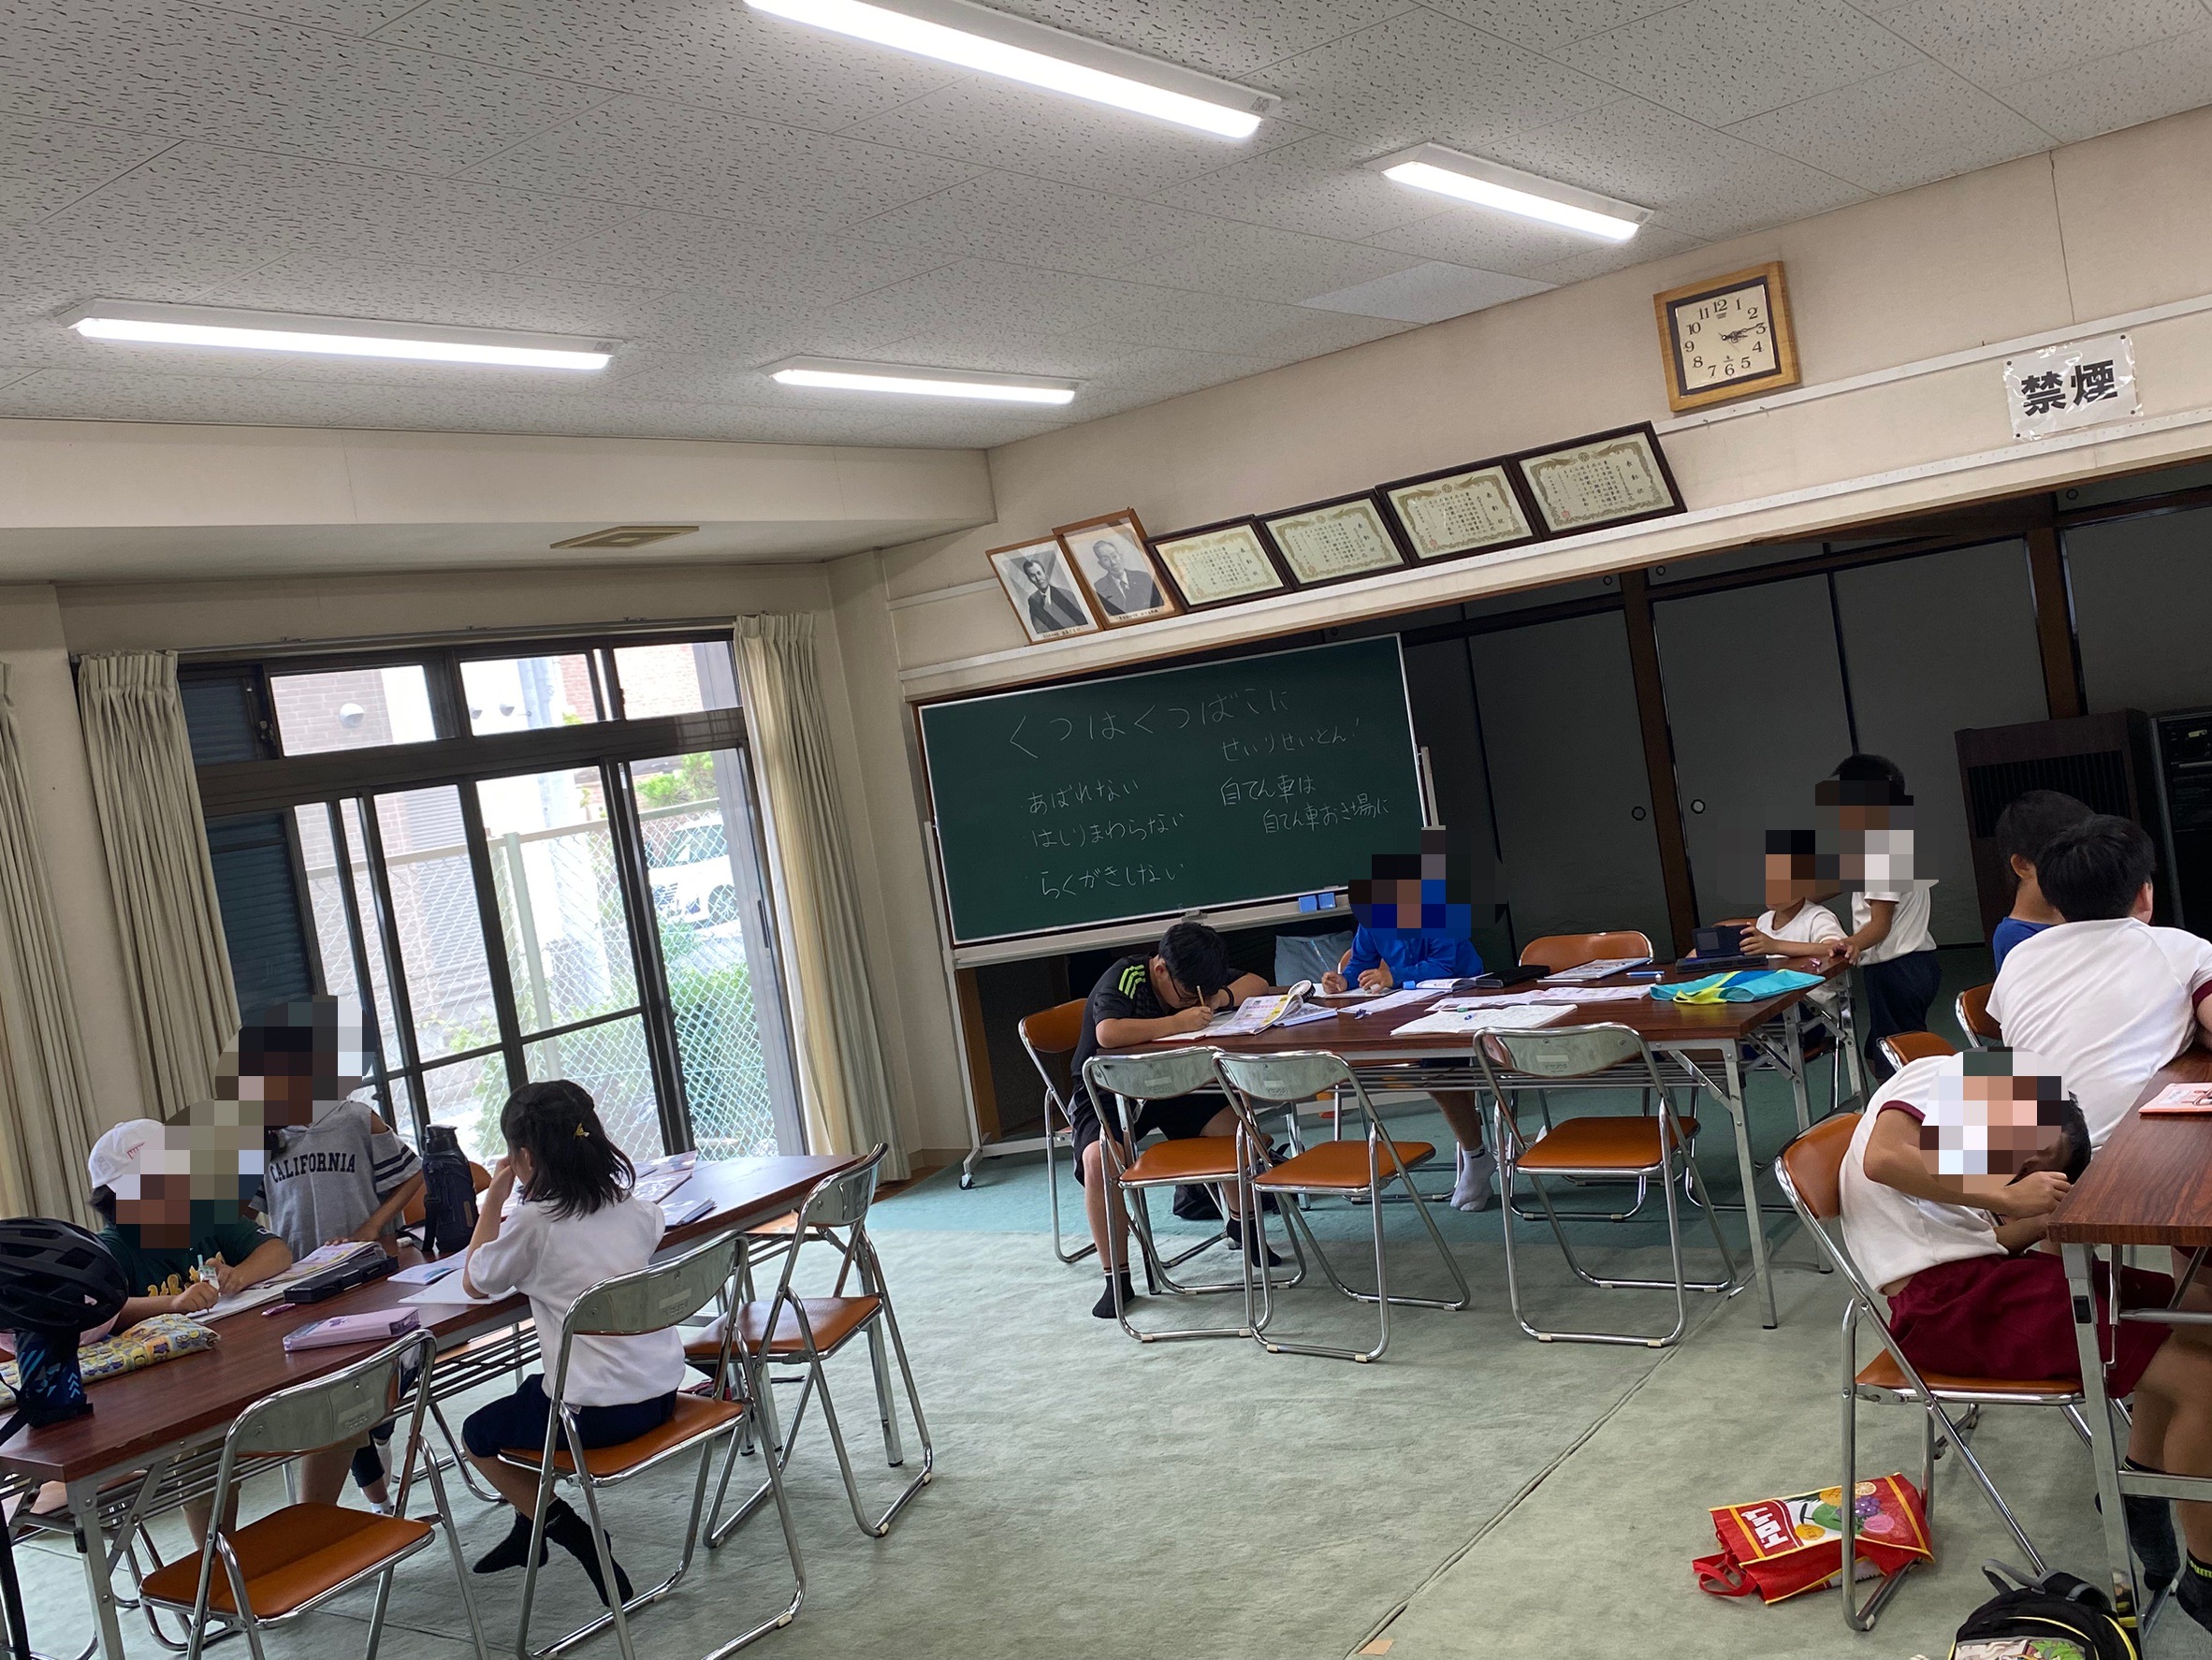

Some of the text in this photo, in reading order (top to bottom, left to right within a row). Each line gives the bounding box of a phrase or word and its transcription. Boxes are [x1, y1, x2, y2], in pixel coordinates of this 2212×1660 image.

[1713, 299, 1727, 313] 12
[1736, 297, 1742, 311] 1
[1699, 308, 1710, 320] 11
[1748, 307, 1758, 319] 2
[1687, 323, 1701, 335] 10
[1756, 323, 1767, 334] 3
[1685, 342, 1695, 352] 9
[1753, 342, 1762, 353] 4
[1694, 357, 1703, 368] 8
[1741, 357, 1751, 368] 5
[1708, 365, 1717, 378] 7
[1725, 365, 1735, 376] 6
[2021, 359, 2118, 417] 禁煙
[1009, 689, 1289, 759] くつはくつばこに
[1219, 773, 1317, 807] 自てん車は
[1027, 779, 1139, 815] あばれない
[1262, 793, 1390, 834] 自てん車おき場に
[1031, 813, 1185, 848] はしりまわらない
[1041, 863, 1185, 899] らくがきしない
[269, 1152, 356, 1184] CALIFORNIA
